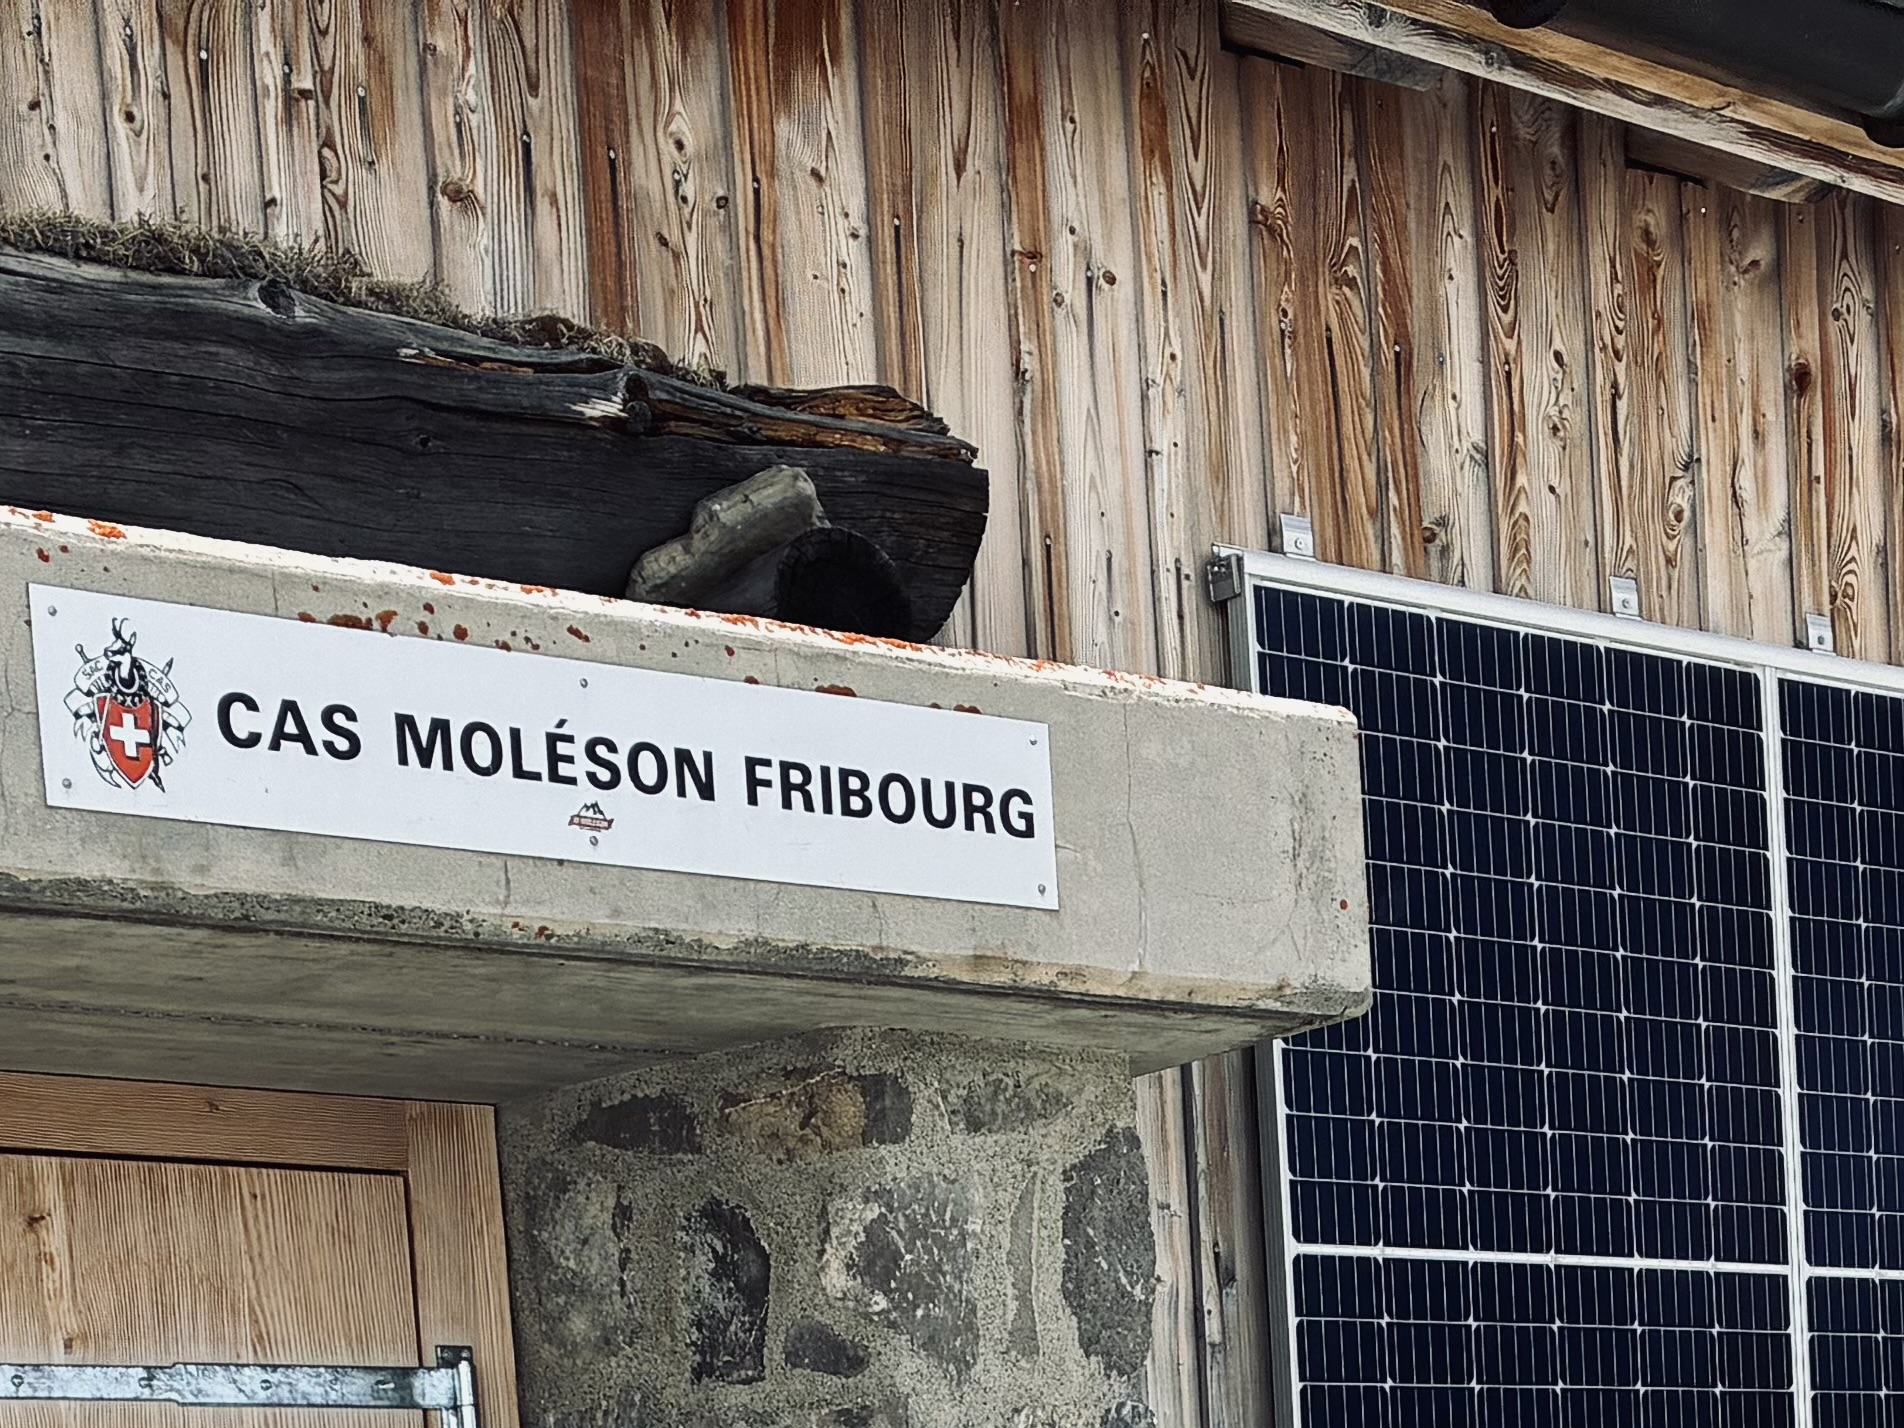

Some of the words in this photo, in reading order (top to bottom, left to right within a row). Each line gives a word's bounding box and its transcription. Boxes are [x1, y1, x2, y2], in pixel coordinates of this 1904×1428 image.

[148, 668, 172, 694] CAS
[217, 692, 362, 761] CAS
[394, 713, 716, 802] MOLÉSON
[744, 755, 1036, 839] FRIBOURG
